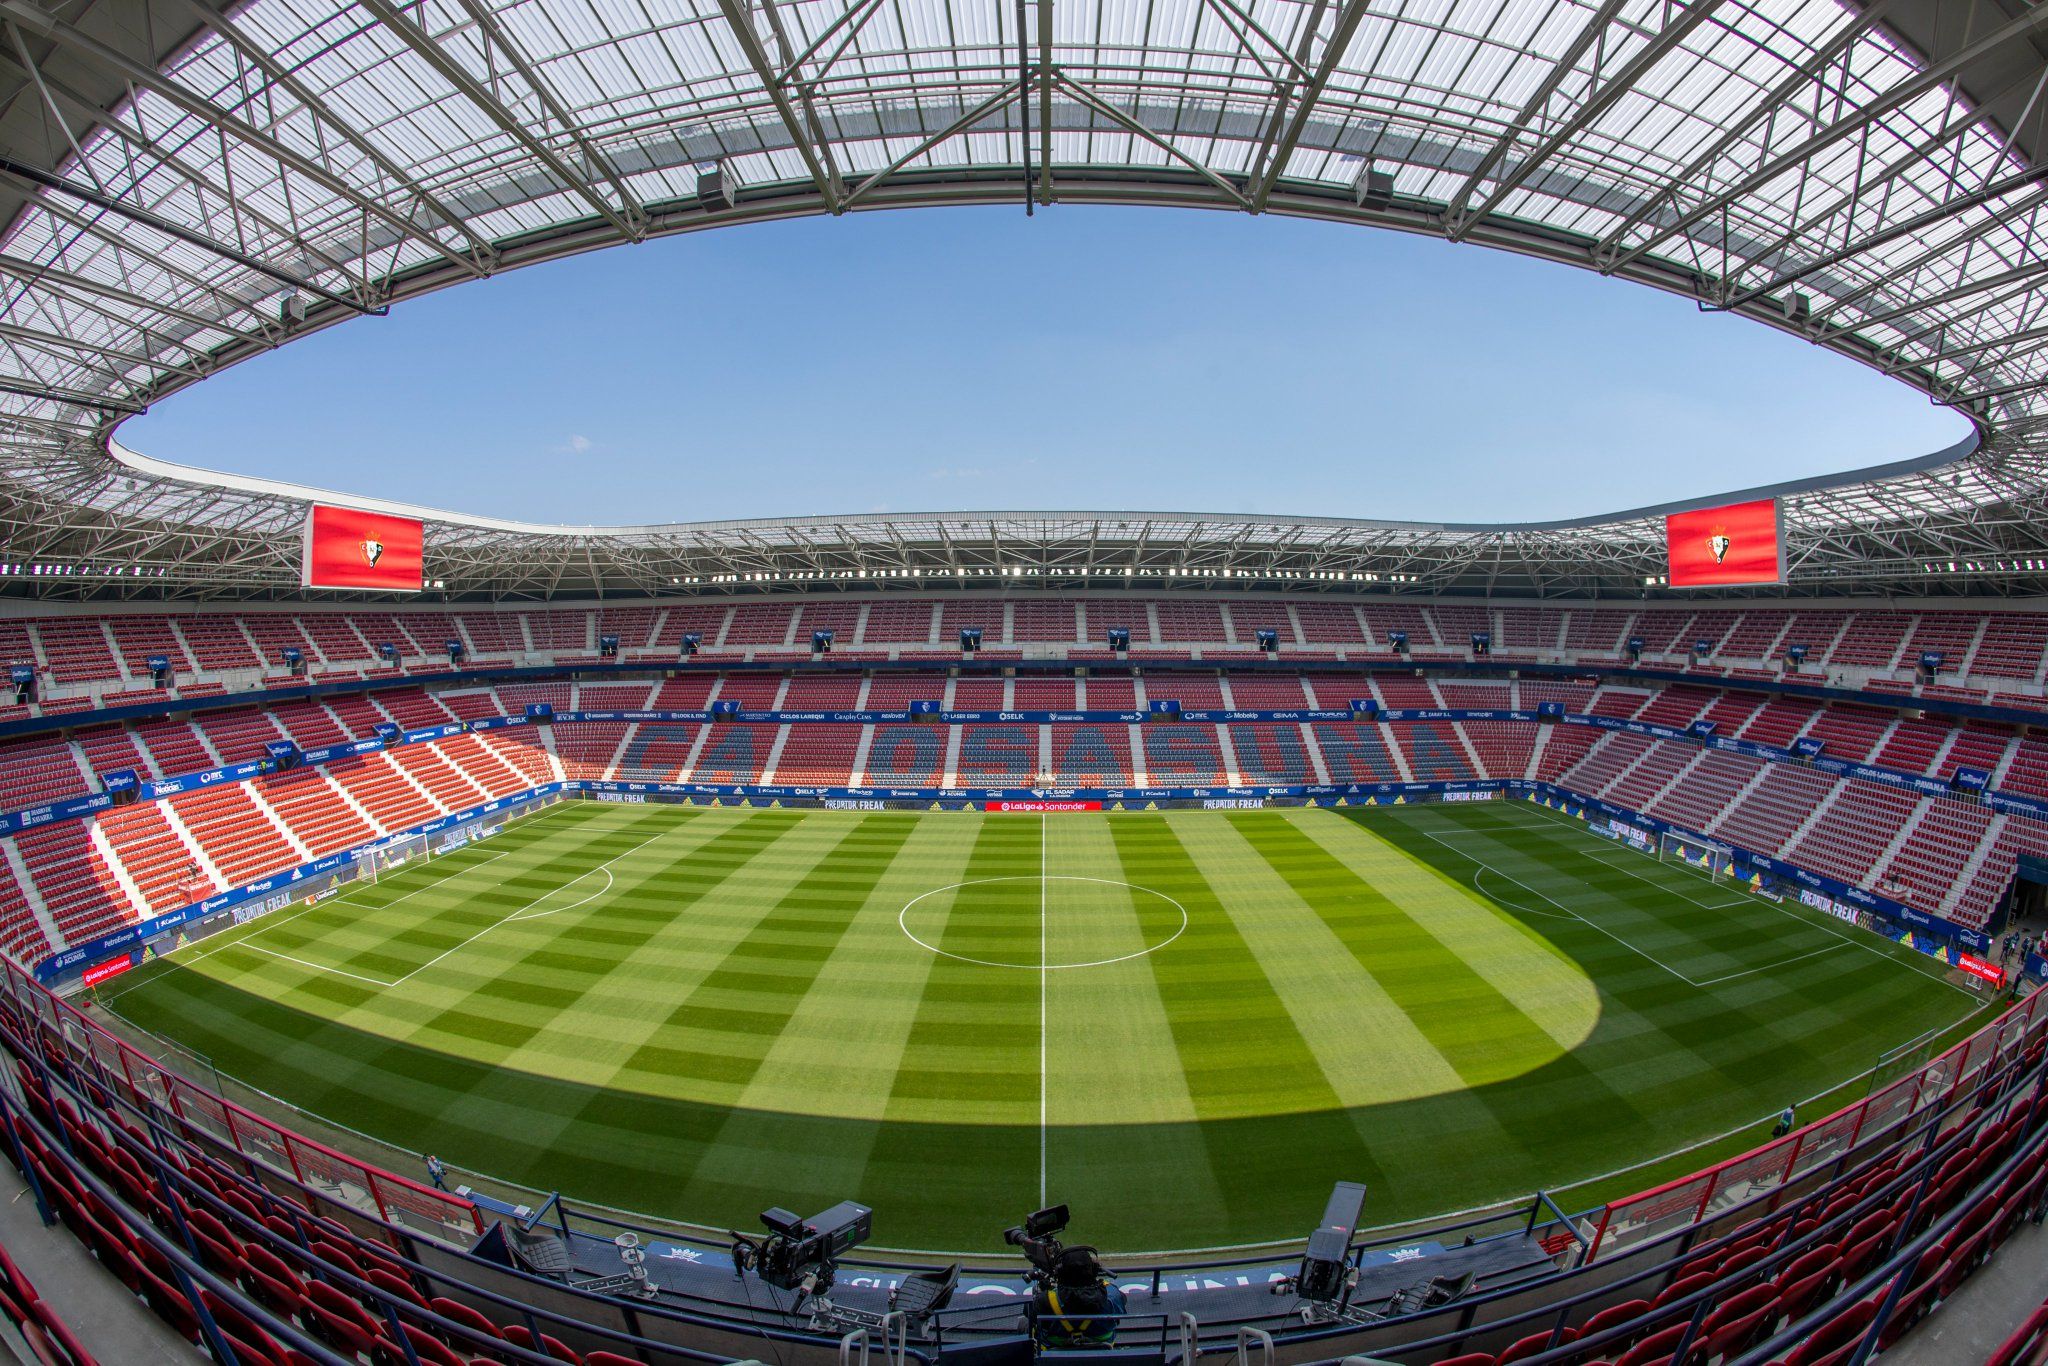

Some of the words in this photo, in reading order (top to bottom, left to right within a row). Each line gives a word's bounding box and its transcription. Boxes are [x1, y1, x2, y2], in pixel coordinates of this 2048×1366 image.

[1915, 779, 1946, 792] PAVANA
[624, 794, 645, 803] FREAK
[1472, 791, 1492, 800] FREAK
[859, 801, 885, 810] FREAK
[1010, 802, 1035, 811] LaLiga
[1044, 801, 1086, 810] Santander
[1239, 799, 1263, 808] FREAK
[267, 891, 292, 912] FREAK
[1832, 902, 1859, 925] FREAK
